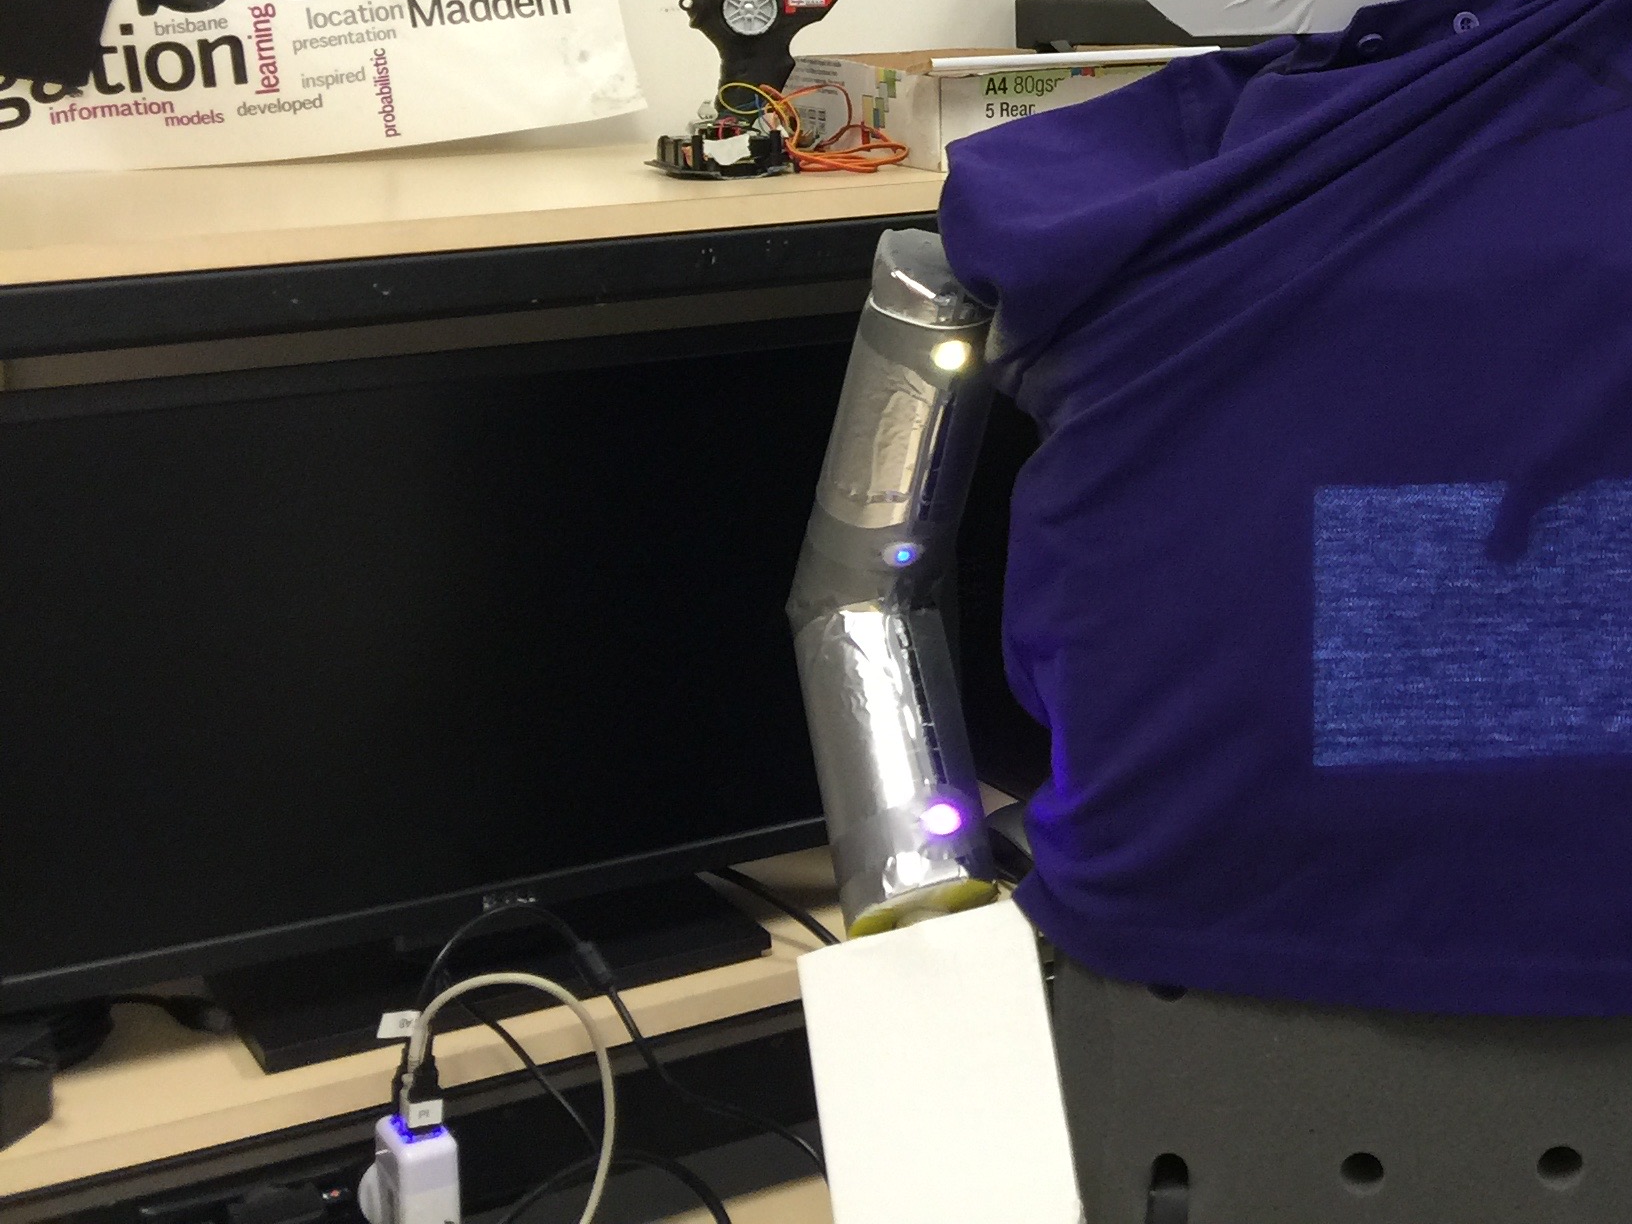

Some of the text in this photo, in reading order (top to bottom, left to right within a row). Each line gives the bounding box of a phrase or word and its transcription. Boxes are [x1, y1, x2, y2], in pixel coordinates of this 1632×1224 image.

[154, 17, 229, 36] brisbane
[305, 1, 405, 29] location
[248, 2, 280, 95] learning
[292, 27, 397, 55] presentation
[301, 66, 366, 90] inspired
[985, 77, 1009, 96] A4
[369, 47, 401, 138] probabilistic
[49, 97, 175, 126] information
[237, 93, 323, 117] developed
[985, 103, 995, 119] 5
[164, 109, 225, 127] models
